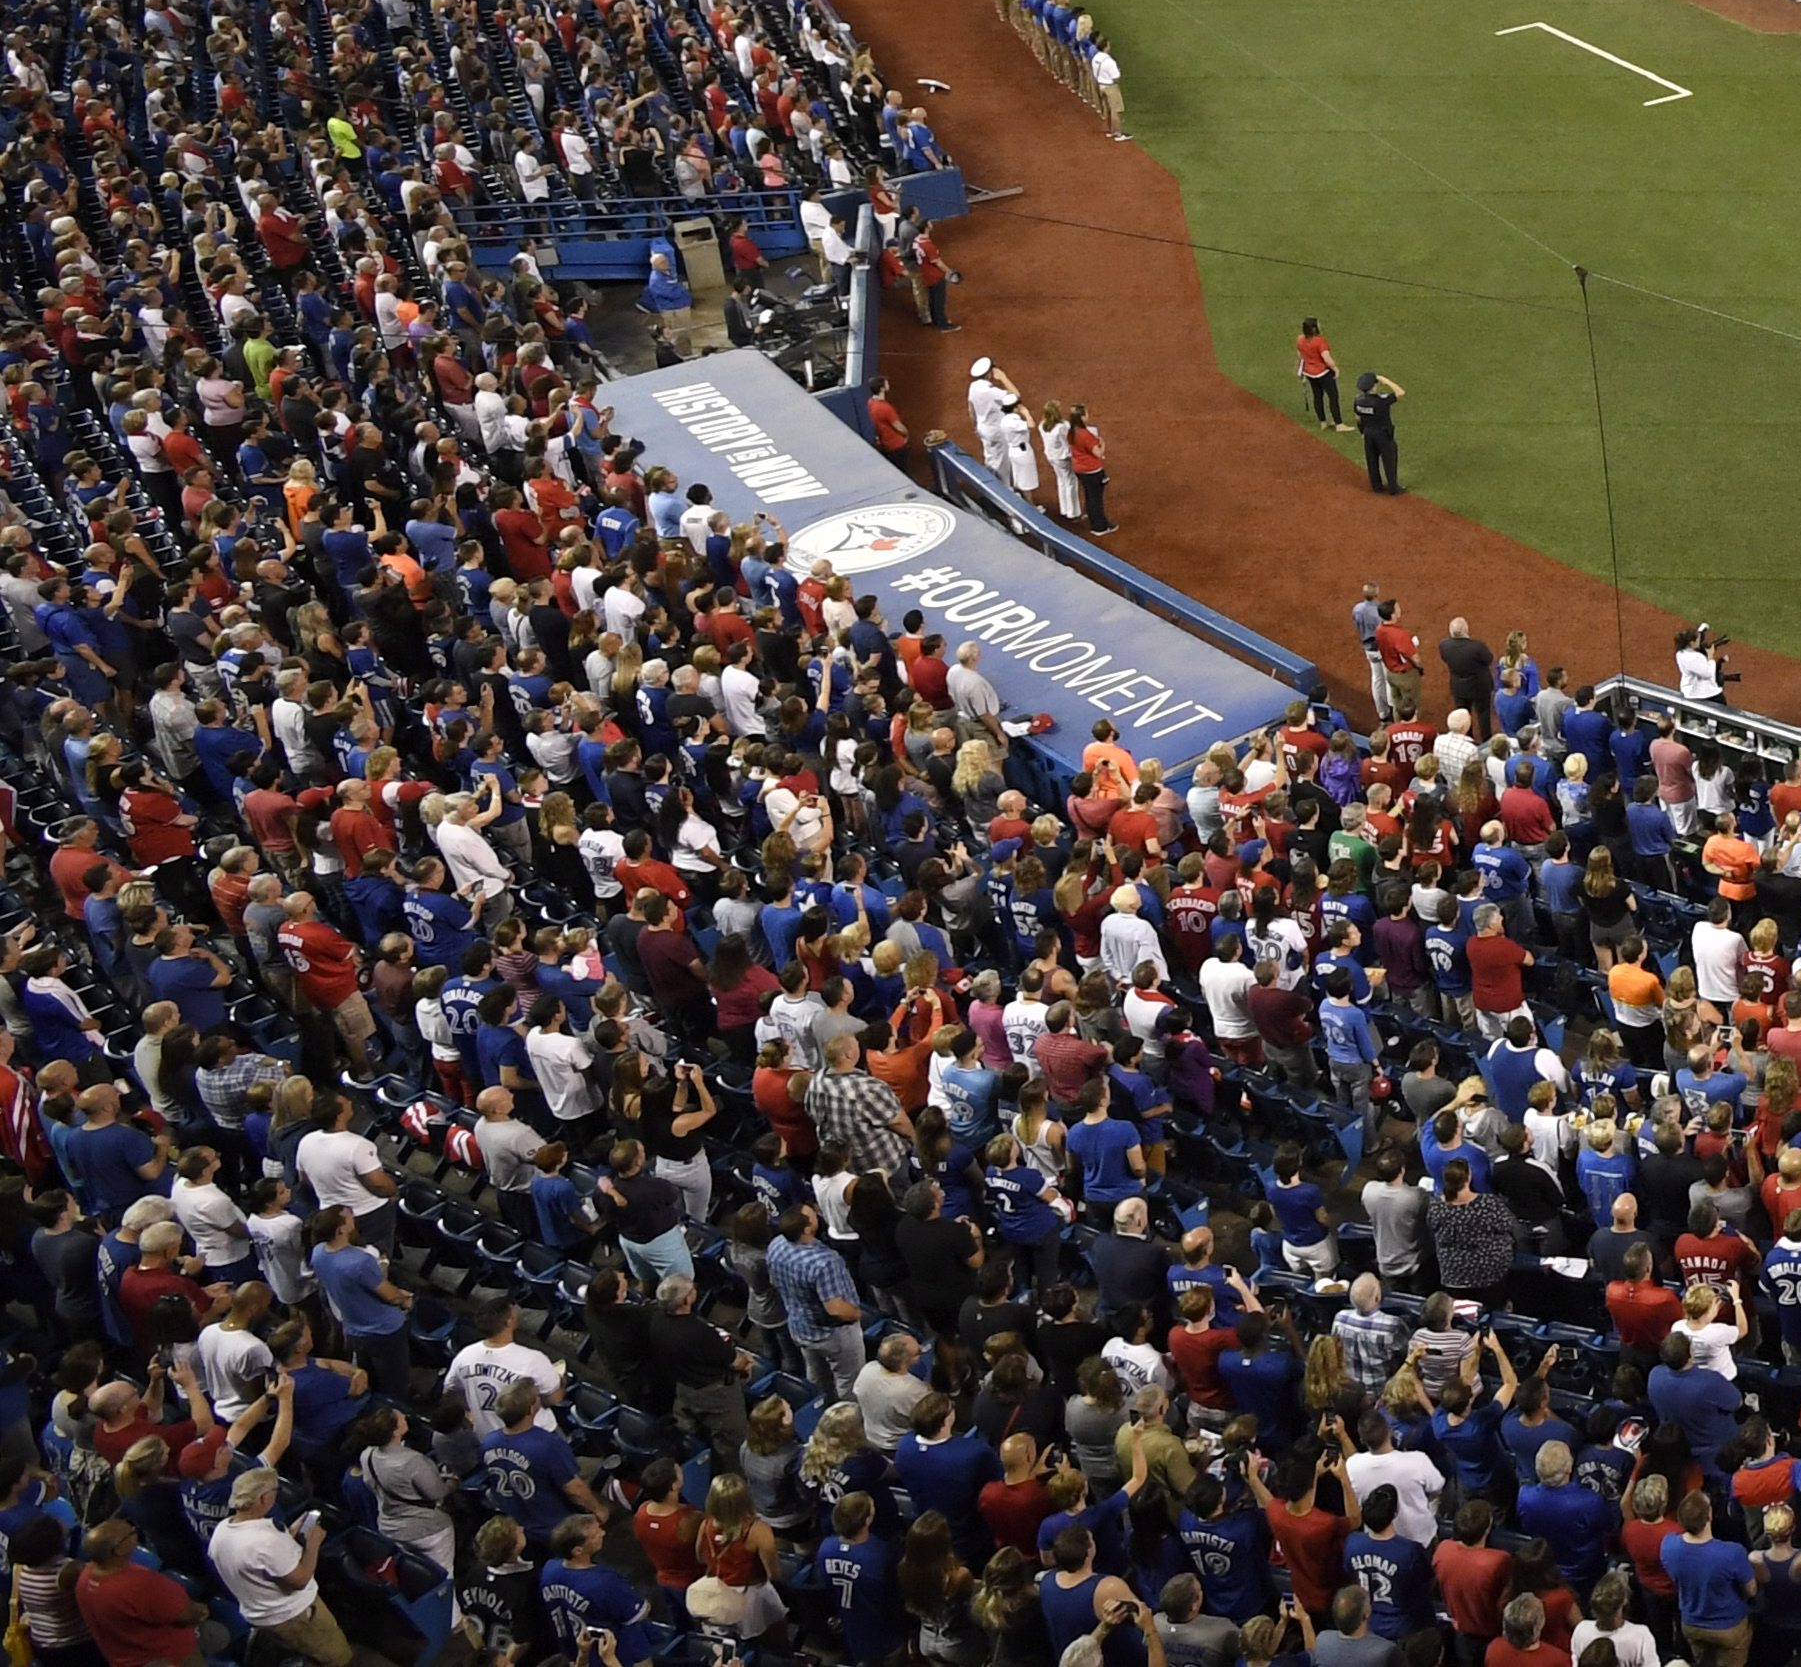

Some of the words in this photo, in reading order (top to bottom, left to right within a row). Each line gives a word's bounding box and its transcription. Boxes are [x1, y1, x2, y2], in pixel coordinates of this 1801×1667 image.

[652, 382, 774, 453] HISTORY
[729, 453, 830, 504] NOW
[890, 565, 1224, 738] #OURMOMENT
[825, 1558, 862, 1580] REYES
[1350, 1554, 1398, 1577] ALOMAR
[832, 1577, 854, 1609] 7
